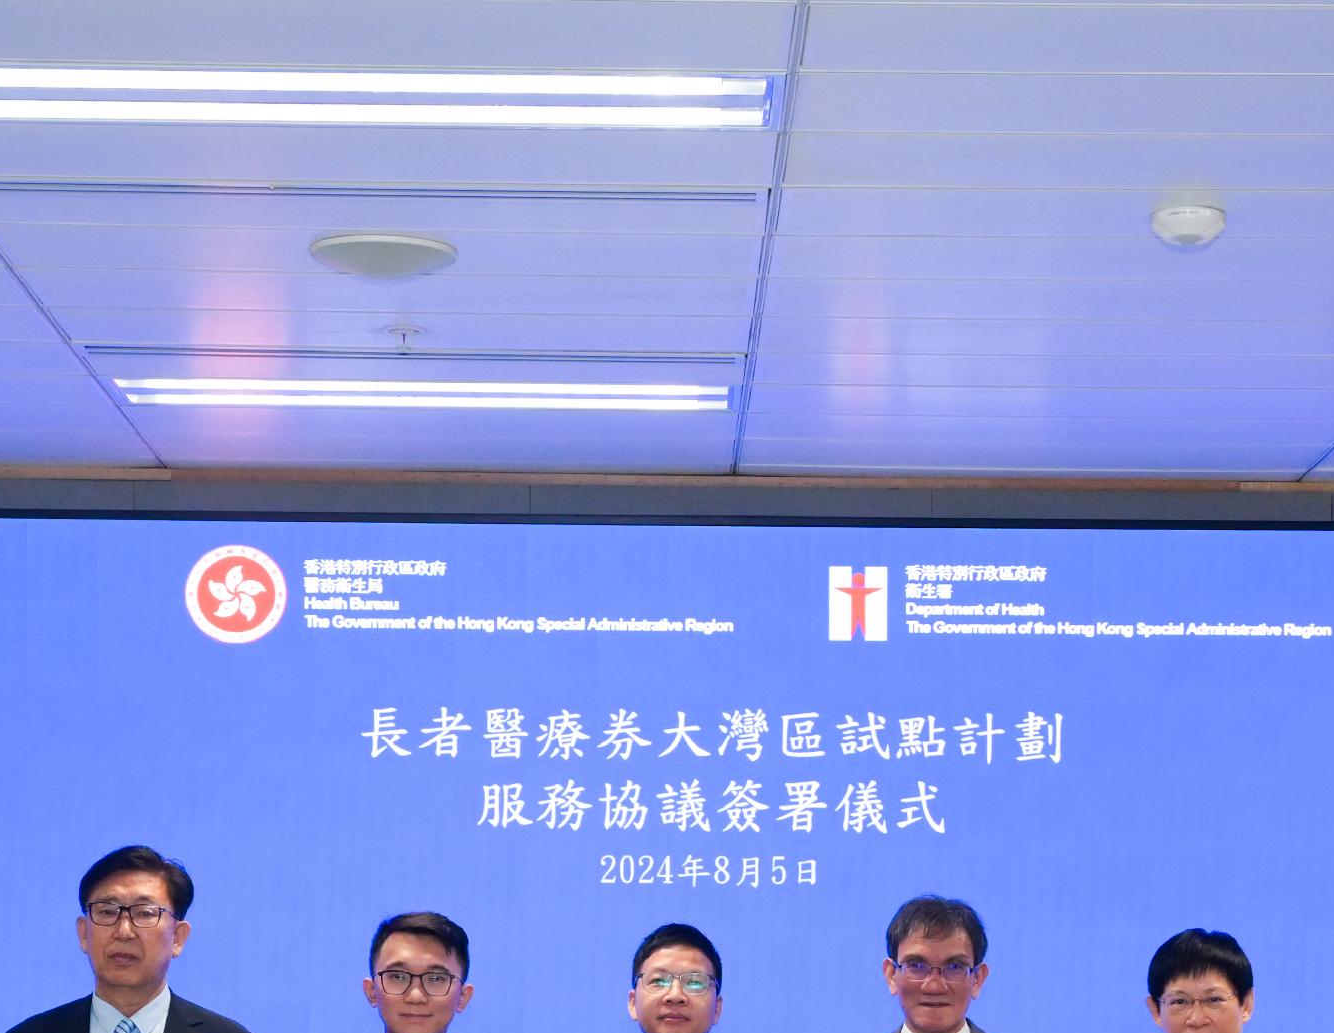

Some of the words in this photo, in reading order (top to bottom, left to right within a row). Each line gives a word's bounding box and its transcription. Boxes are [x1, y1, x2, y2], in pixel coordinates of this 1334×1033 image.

[304, 595, 348, 610] Health
[347, 597, 399, 610] Bureau
[906, 602, 984, 618] Department
[985, 603, 1000, 615] of
[999, 603, 1045, 616] Health
[305, 615, 330, 628] The
[332, 615, 416, 629] Government
[418, 616, 432, 629] of
[433, 616, 455, 629] the
[456, 616, 495, 633] Hong
[497, 617, 534, 633] Kong
[537, 617, 585, 633] Special
[587, 618, 683, 631] Administrative
[685, 619, 734, 635] Region
[907, 621, 931, 633] The
[933, 621, 1016, 634] Government
[1018, 622, 1031, 634] of
[1033, 622, 1055, 634] the
[1057, 622, 1095, 637] Hong
[1096, 622, 1134, 638] Kong
[1136, 622, 1184, 638] Special
[1186, 623, 1282, 636] Administrative
[1284, 623, 1332, 639] Region
[361, 707, 1063, 764] 長者醫療券大灣區試點計劃
[477, 779, 945, 833] 服務協議簽署儀式
[600, 855, 816, 888] 2024年8月5日
